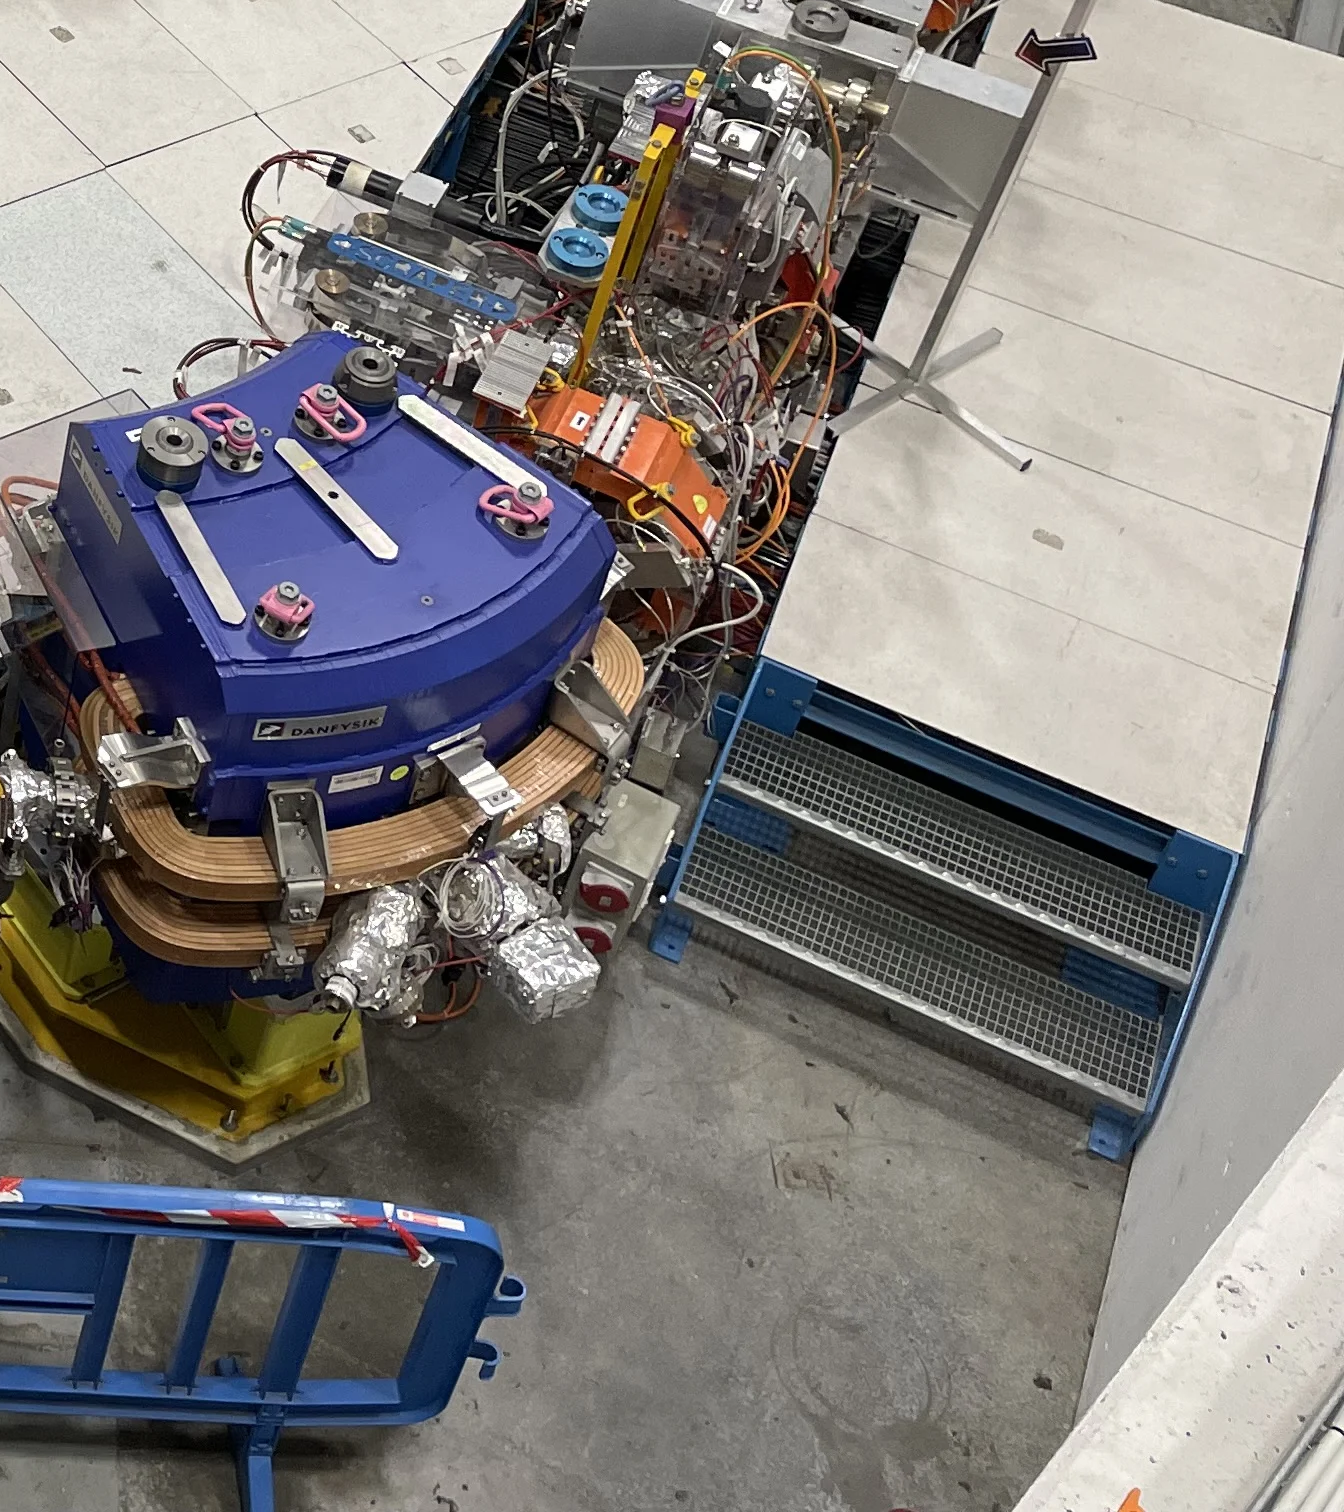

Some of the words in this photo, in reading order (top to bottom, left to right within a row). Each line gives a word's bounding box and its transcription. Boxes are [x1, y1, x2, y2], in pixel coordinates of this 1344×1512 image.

[354, 244, 486, 308] SCRAPER
[82, 470, 121, 537] DANFYSIK
[291, 717, 380, 737] DANFYSIK
